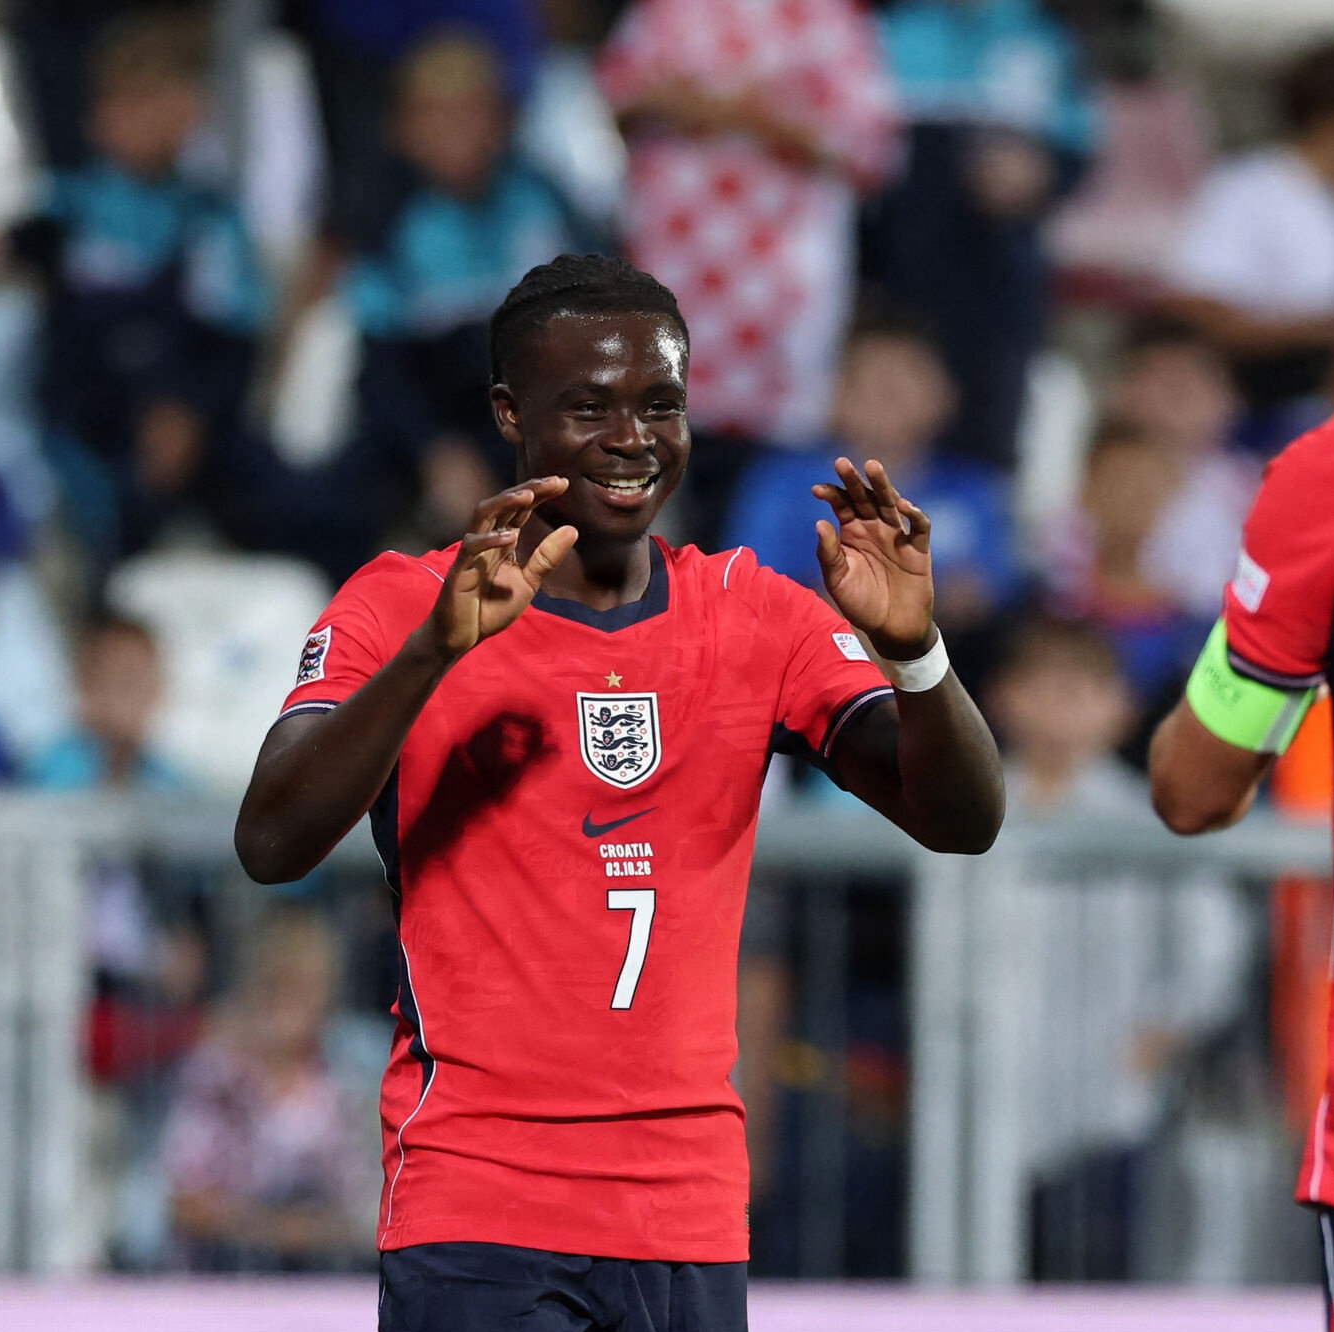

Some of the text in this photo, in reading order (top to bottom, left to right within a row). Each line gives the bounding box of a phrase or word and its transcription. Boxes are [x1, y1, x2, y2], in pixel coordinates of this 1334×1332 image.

[599, 842, 654, 859] CROATIA
[605, 860, 652, 877] 03.10.26
[606, 888, 657, 1010] 7
